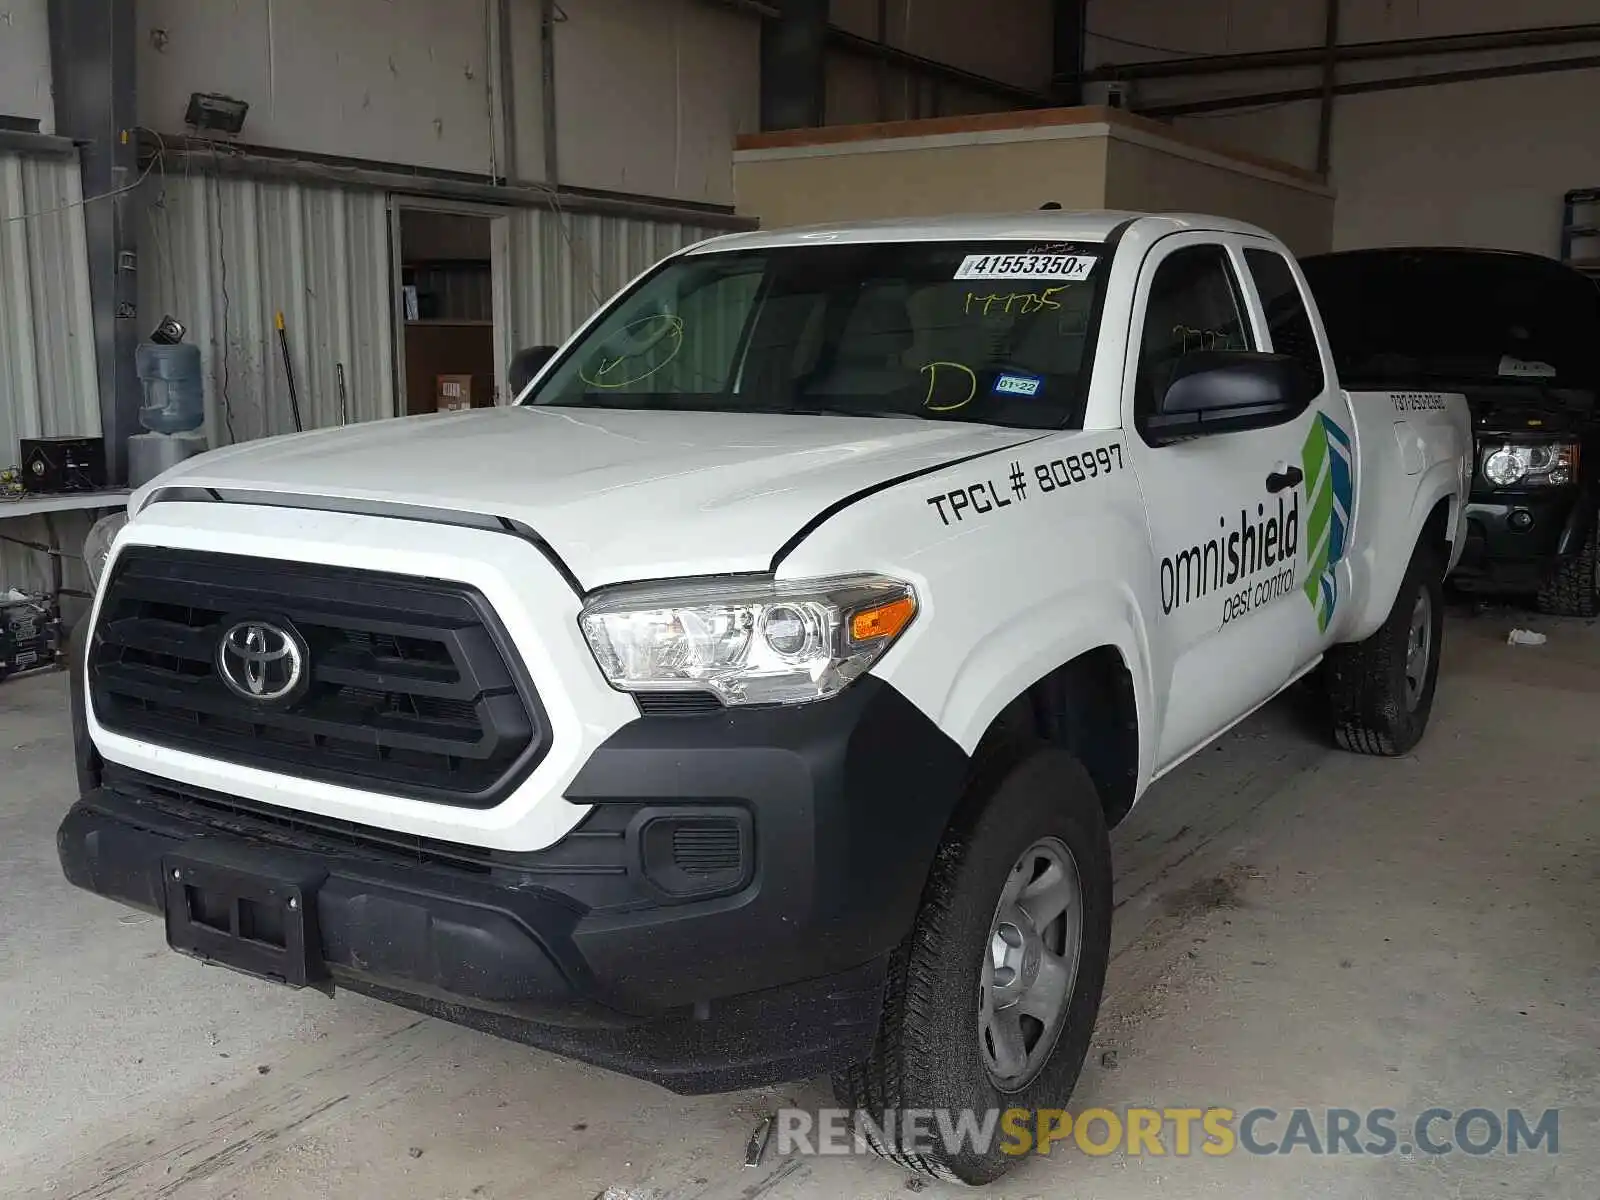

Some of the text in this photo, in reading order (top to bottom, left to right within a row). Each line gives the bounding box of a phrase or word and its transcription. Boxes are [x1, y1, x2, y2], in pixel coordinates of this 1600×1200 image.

[1034, 443, 1123, 493] 808997
[1160, 491, 1298, 616] omnishield
[1217, 558, 1296, 633] pest control
